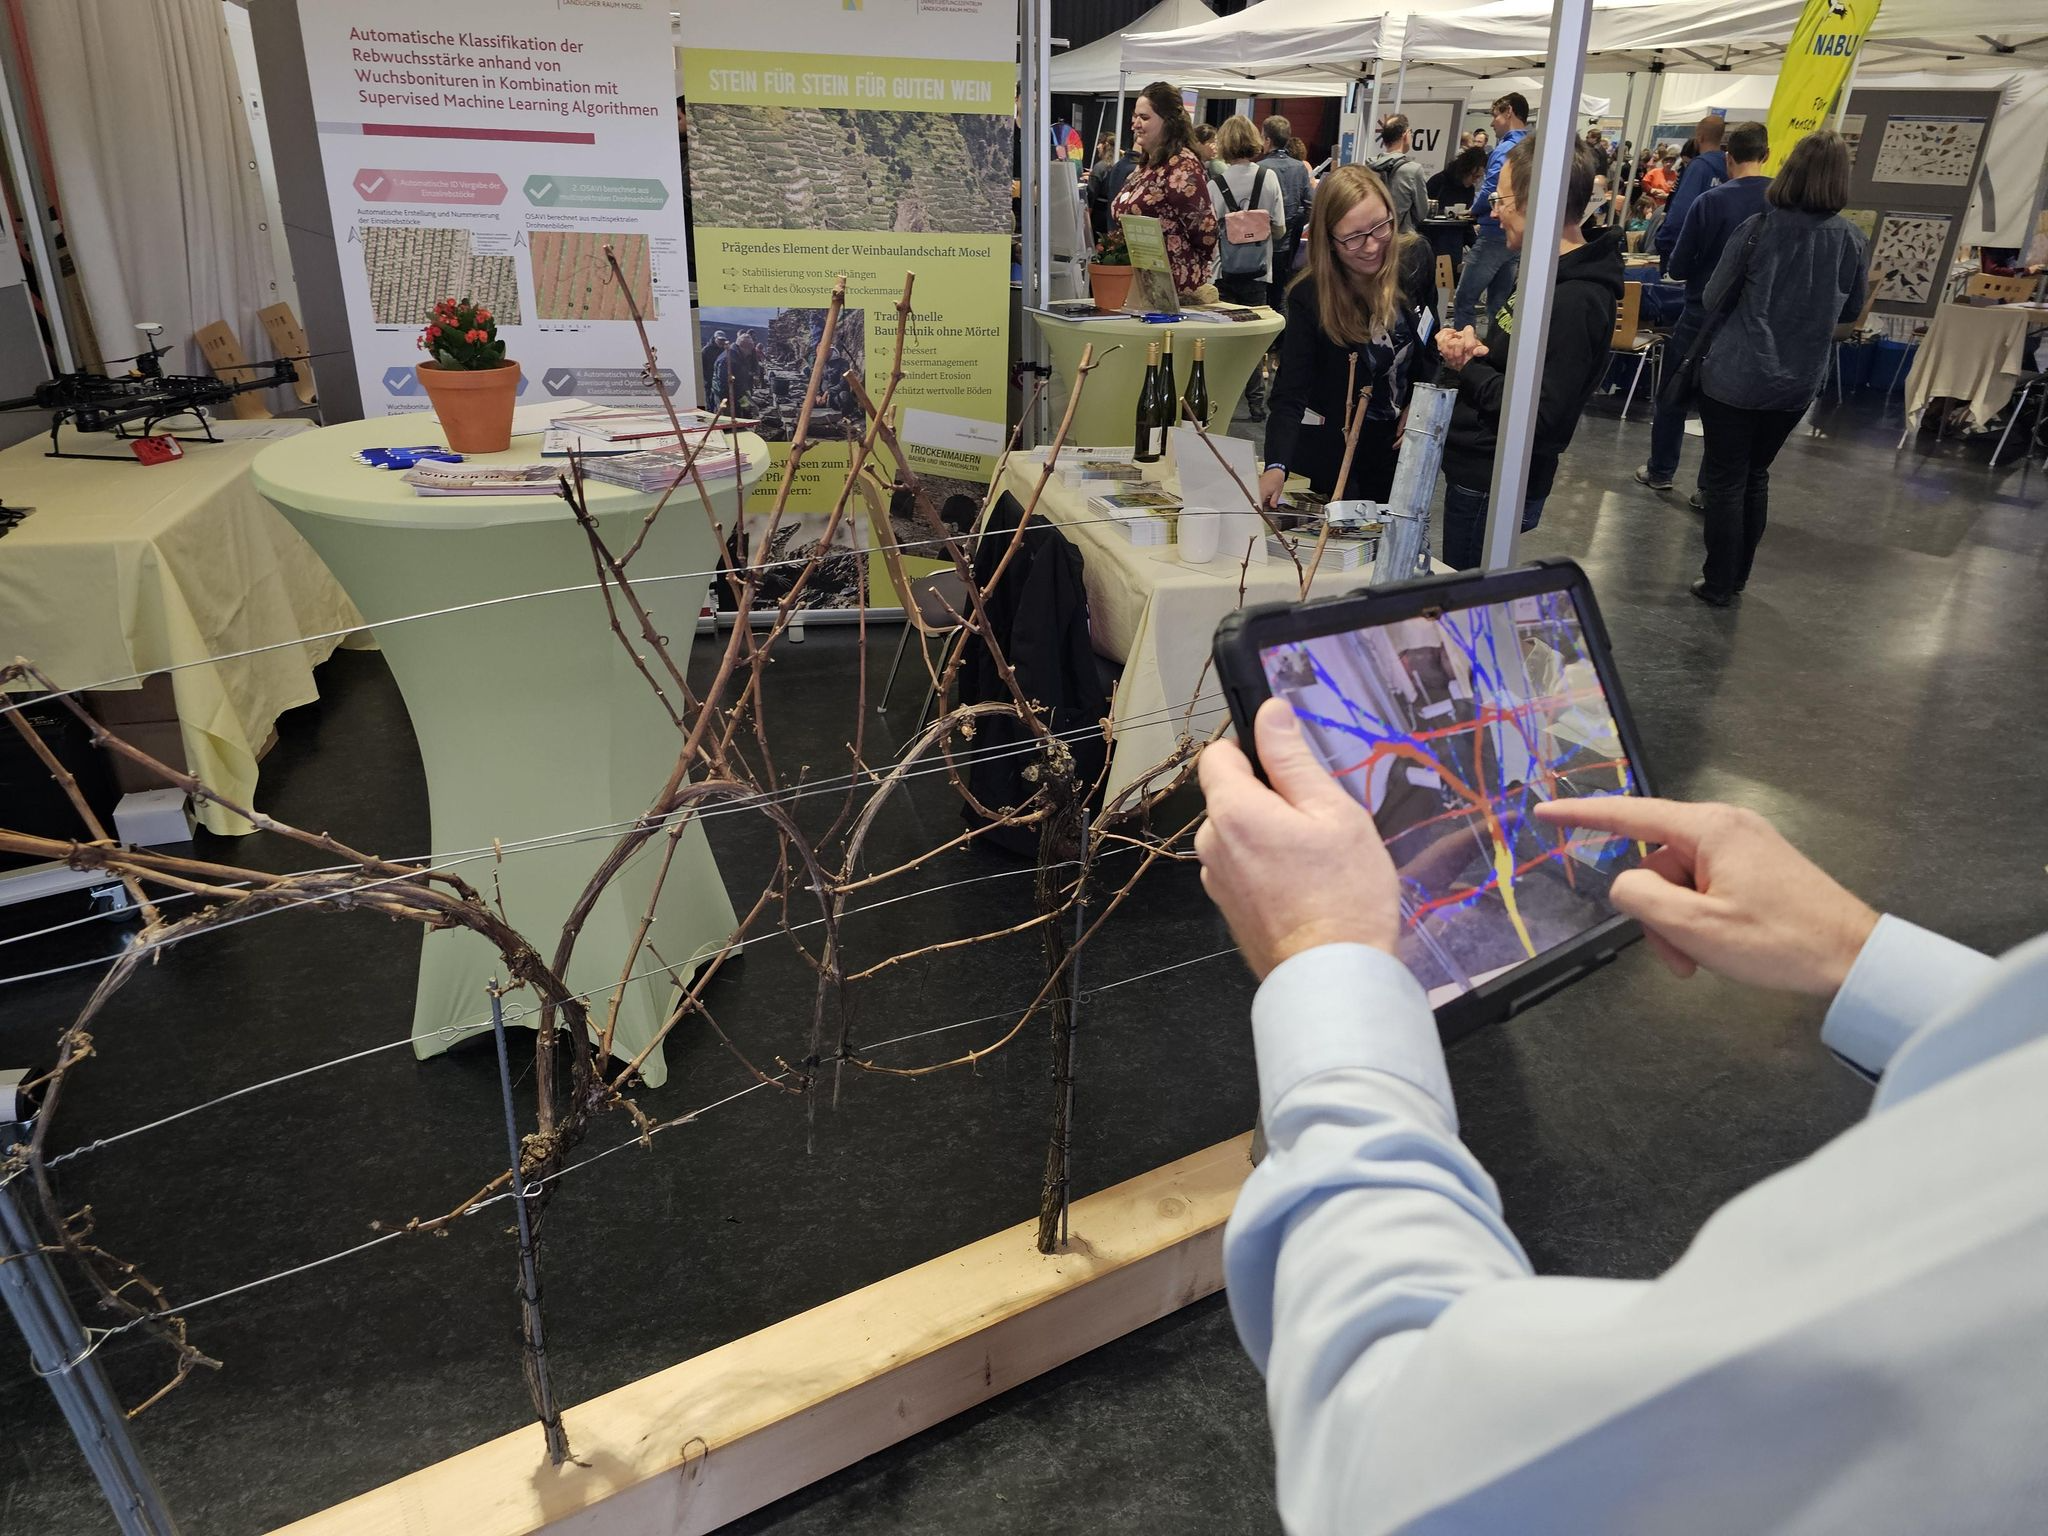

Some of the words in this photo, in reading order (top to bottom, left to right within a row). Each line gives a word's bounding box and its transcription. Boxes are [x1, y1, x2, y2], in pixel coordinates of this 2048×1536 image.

[350, 27, 455, 46] Automatische
[459, 33, 557, 51] Klassifikation
[560, 38, 583, 53] der
[1813, 35, 1859, 56] NABU
[352, 48, 474, 67] Rebwuchsstärke
[478, 54, 531, 71] anhand
[534, 59, 561, 72] von
[355, 69, 479, 88] Wuchsbonituren
[482, 74, 496, 89] in
[500, 76, 591, 94] Kombination
[594, 82, 618, 96] mit
[709, 69, 757, 92] STEIN
[764, 68, 795, 94] FÜR
[802, 73, 849, 96] STEIN
[855, 72, 886, 97] FÜR
[892, 78, 945, 100] GUTEN
[951, 80, 992, 102] WEIN
[359, 90, 440, 108] Supervised
[444, 94, 504, 110] Machine
[508, 98, 569, 117] Learning
[572, 102, 658, 118] Algorithmen
[722, 242, 780, 255] Prägendes
[783, 243, 829, 254] Element
[832, 244, 849, 254] der
[852, 244, 956, 257] Weinbaulandschaft
[959, 247, 991, 258] Mosel
[742, 268, 804, 279] Stabilisierung
[743, 284, 770, 293] Erhalt
[773, 285, 787, 293] des
[845, 286, 904, 295] Trockenmaue
[874, 326, 934, 336] Bautchnik
[936, 326, 962, 336] ohne
[965, 327, 1000, 336] Mörtel
[901, 360, 978, 368] assermanagement
[940, 372, 971, 380] Erosion
[926, 387, 965, 395] wertvolle
[967, 387, 992, 395] Böden
[908, 455, 926, 463] BAUEN
[910, 444, 981, 464] TROCKENMAUERN
